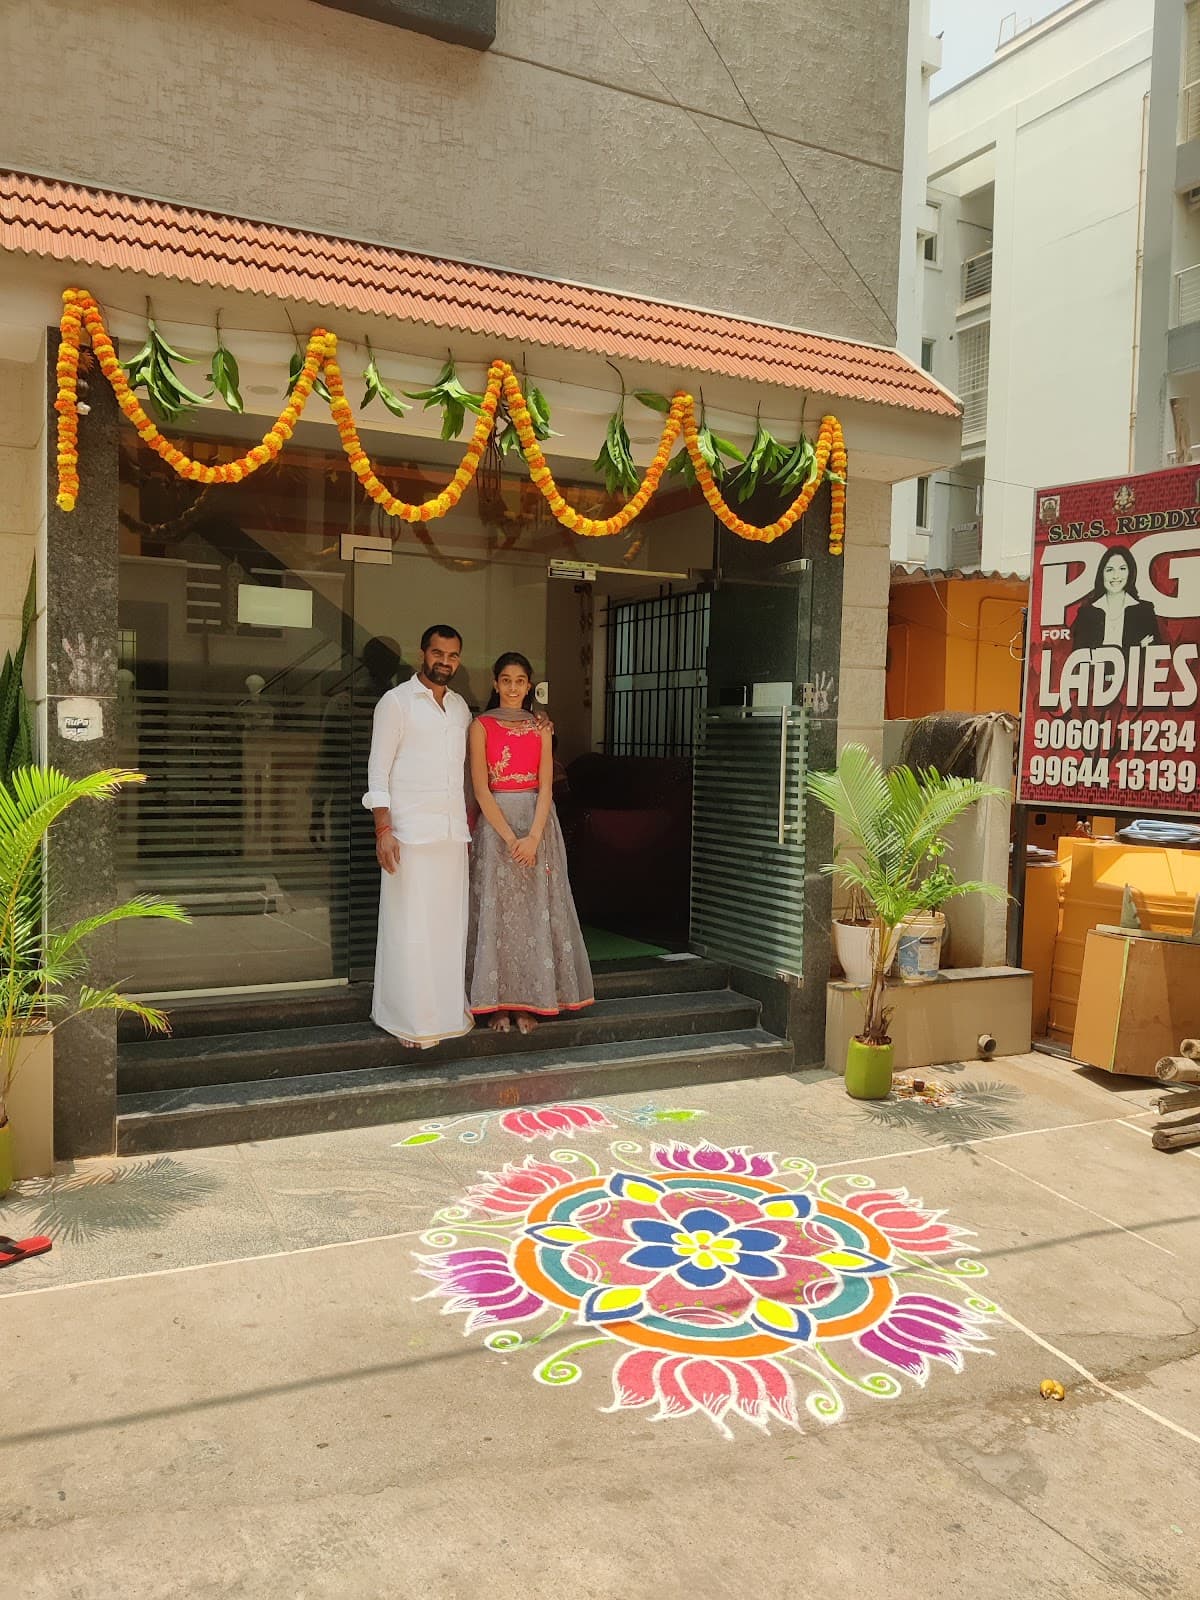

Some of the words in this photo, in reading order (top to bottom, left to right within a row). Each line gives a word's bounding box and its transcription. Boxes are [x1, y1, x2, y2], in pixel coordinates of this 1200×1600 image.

[1048, 519, 1110, 542] S.N.S.
[1116, 508, 1200, 535] REDDY
[1040, 530, 1200, 627] PG
[1041, 629, 1071, 641] FOR
[1038, 643, 1199, 714] LADIES
[1033, 718, 1112, 750] 90601
[1117, 719, 1197, 753] 11234
[1029, 755, 1110, 789] 99644
[1115, 758, 1197, 794] 13139
